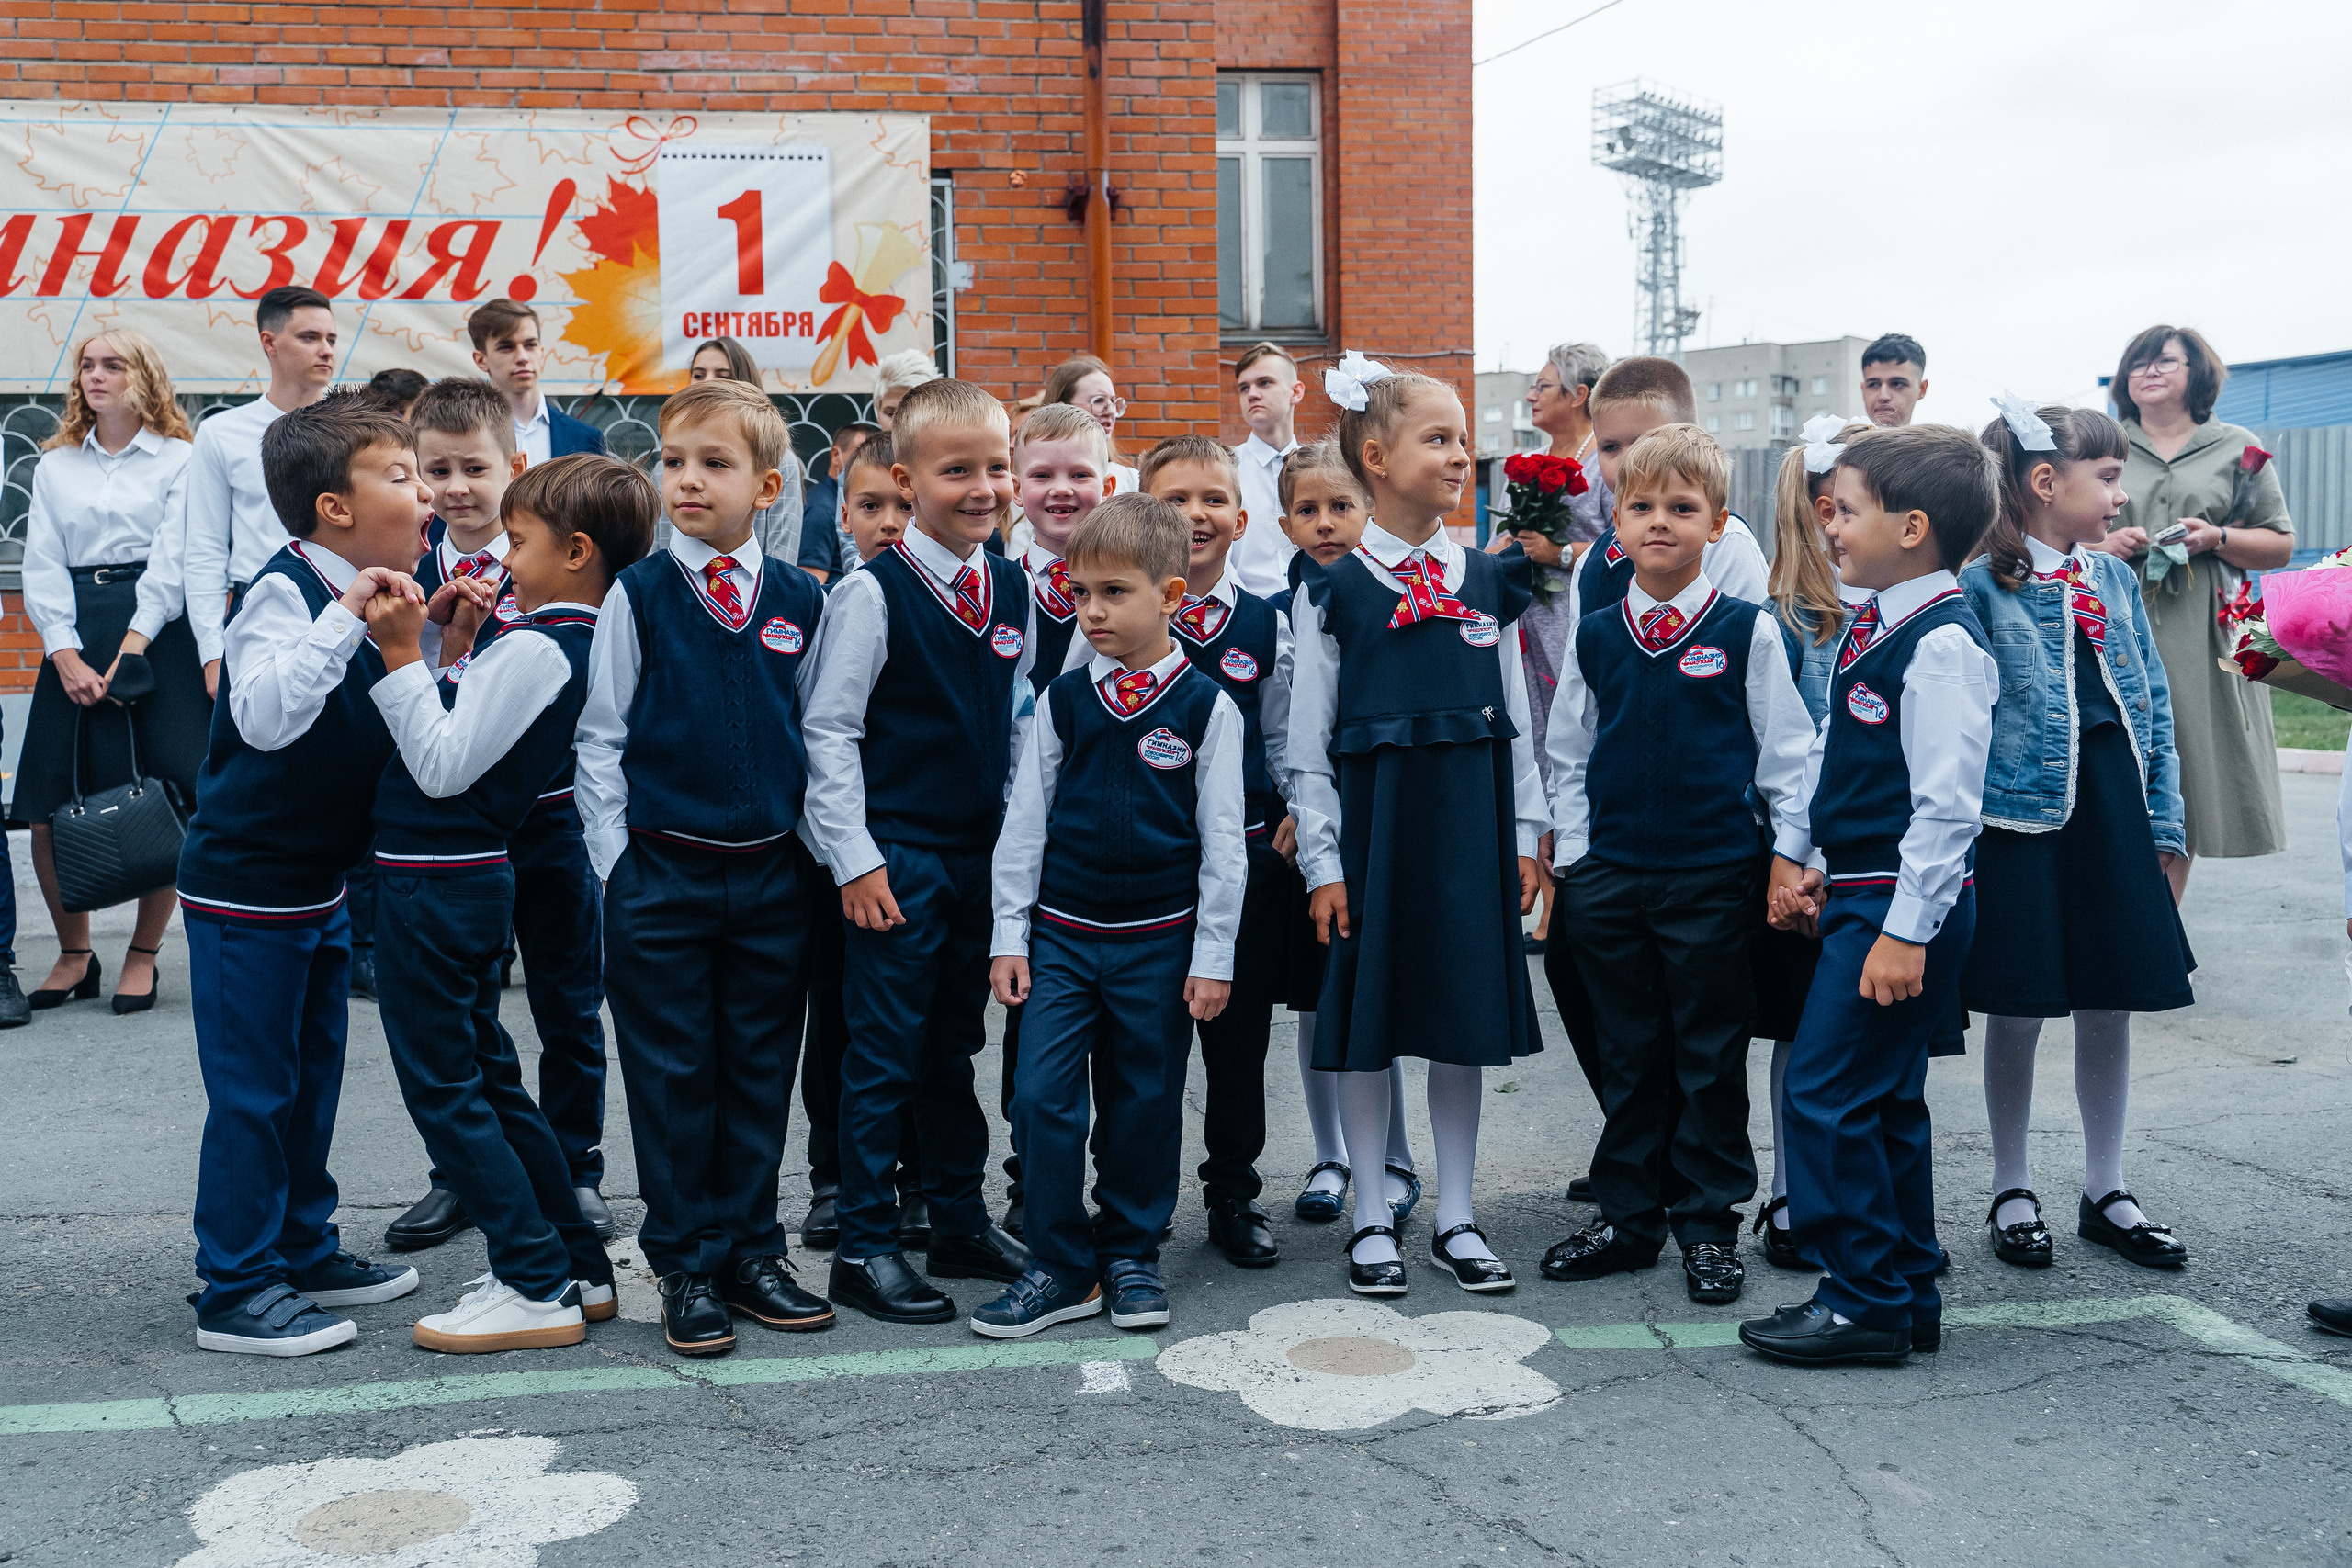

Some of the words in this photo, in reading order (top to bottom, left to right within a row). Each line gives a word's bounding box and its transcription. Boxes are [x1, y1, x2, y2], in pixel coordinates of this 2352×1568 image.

[718, 190, 764, 295] 1
[683, 311, 814, 339] СЕНТЯБРЯ
[794, 637, 802, 649] 16
[1248, 665, 1256, 675] 16
[1714, 658, 1725, 670] 16
[1874, 706, 1885, 720] 16
[1148, 739, 1187, 752] ГИМНАЗИЯ
[1175, 752, 1186, 762] 16
